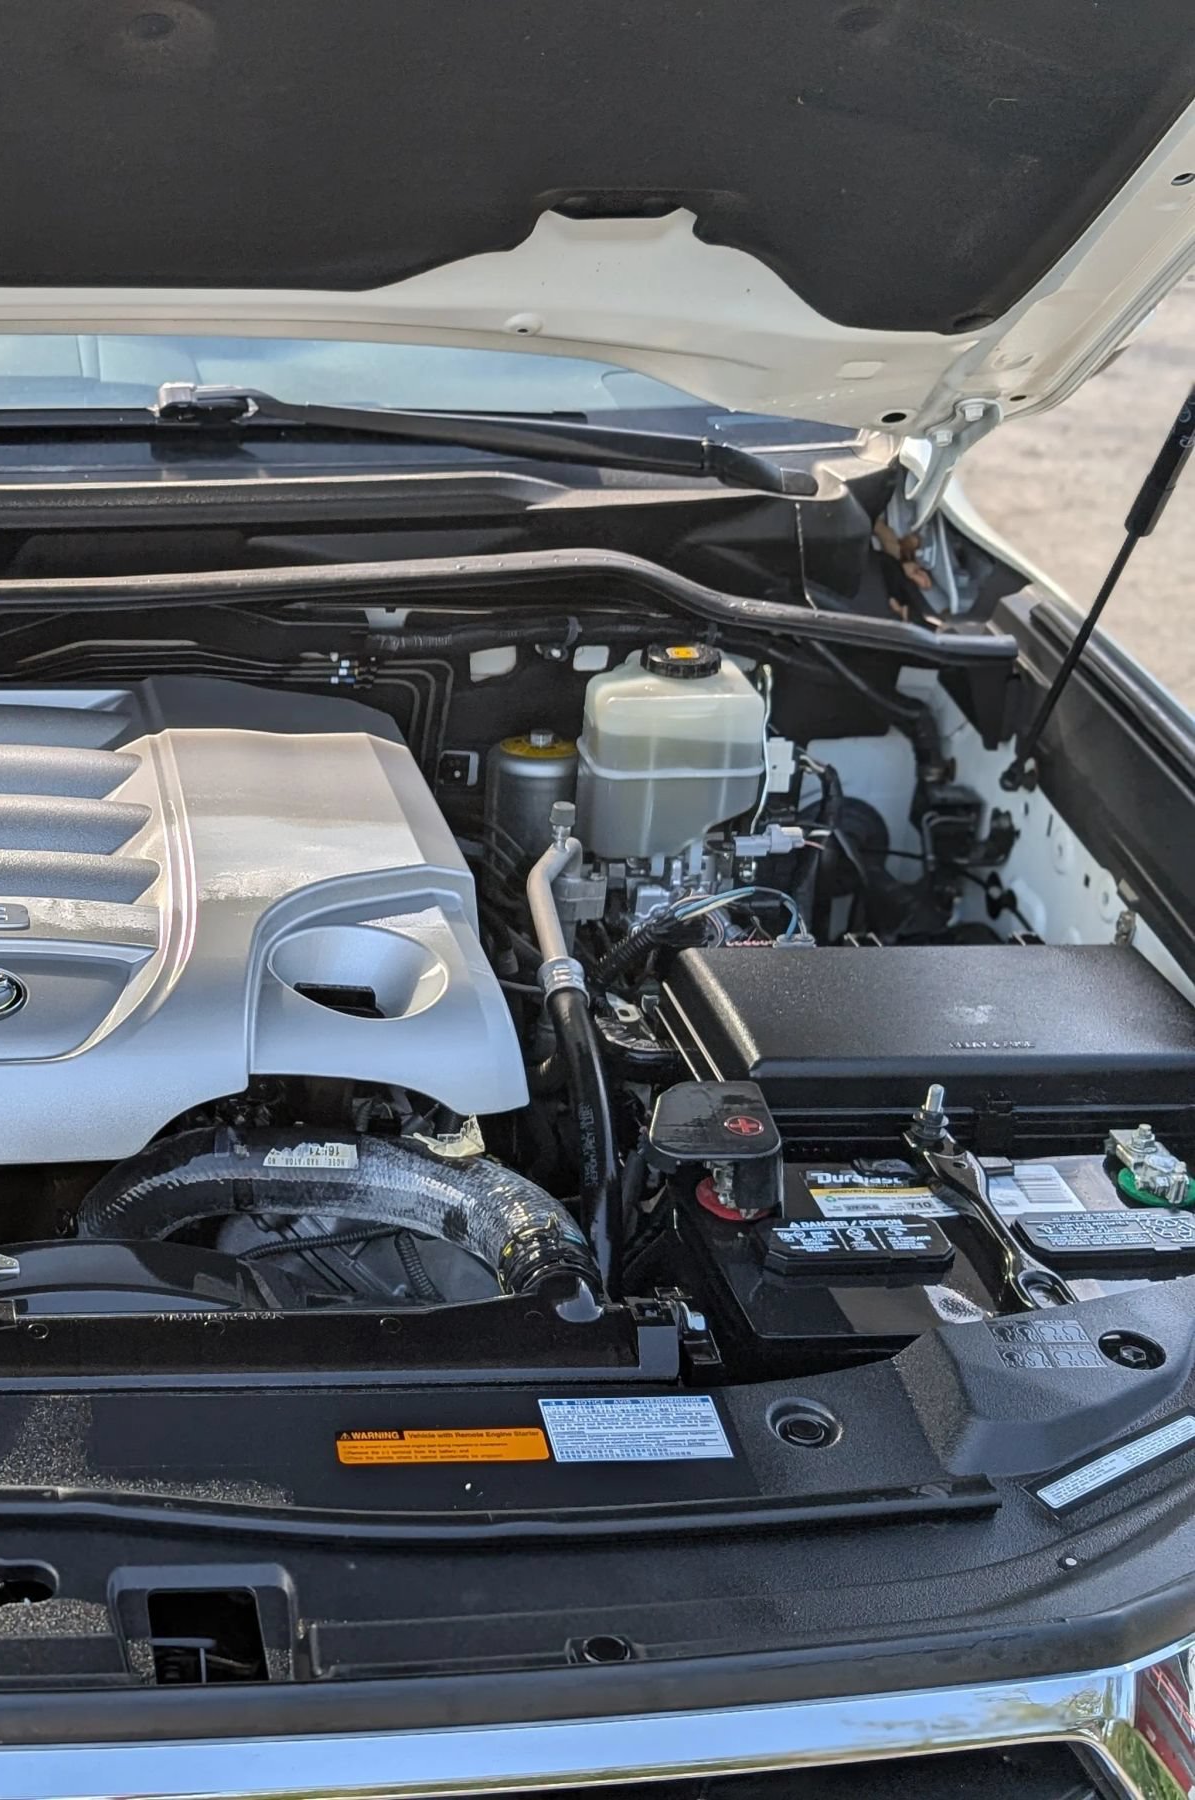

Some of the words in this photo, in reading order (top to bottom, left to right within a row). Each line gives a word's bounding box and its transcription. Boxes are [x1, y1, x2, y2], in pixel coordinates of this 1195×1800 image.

[810, 1172, 903, 1186] Duralast
[908, 1201, 931, 1209] 710
[800, 1220, 849, 1228] DANGER
[859, 1219, 903, 1227] POISON
[351, 1431, 399, 1440] WARNING
